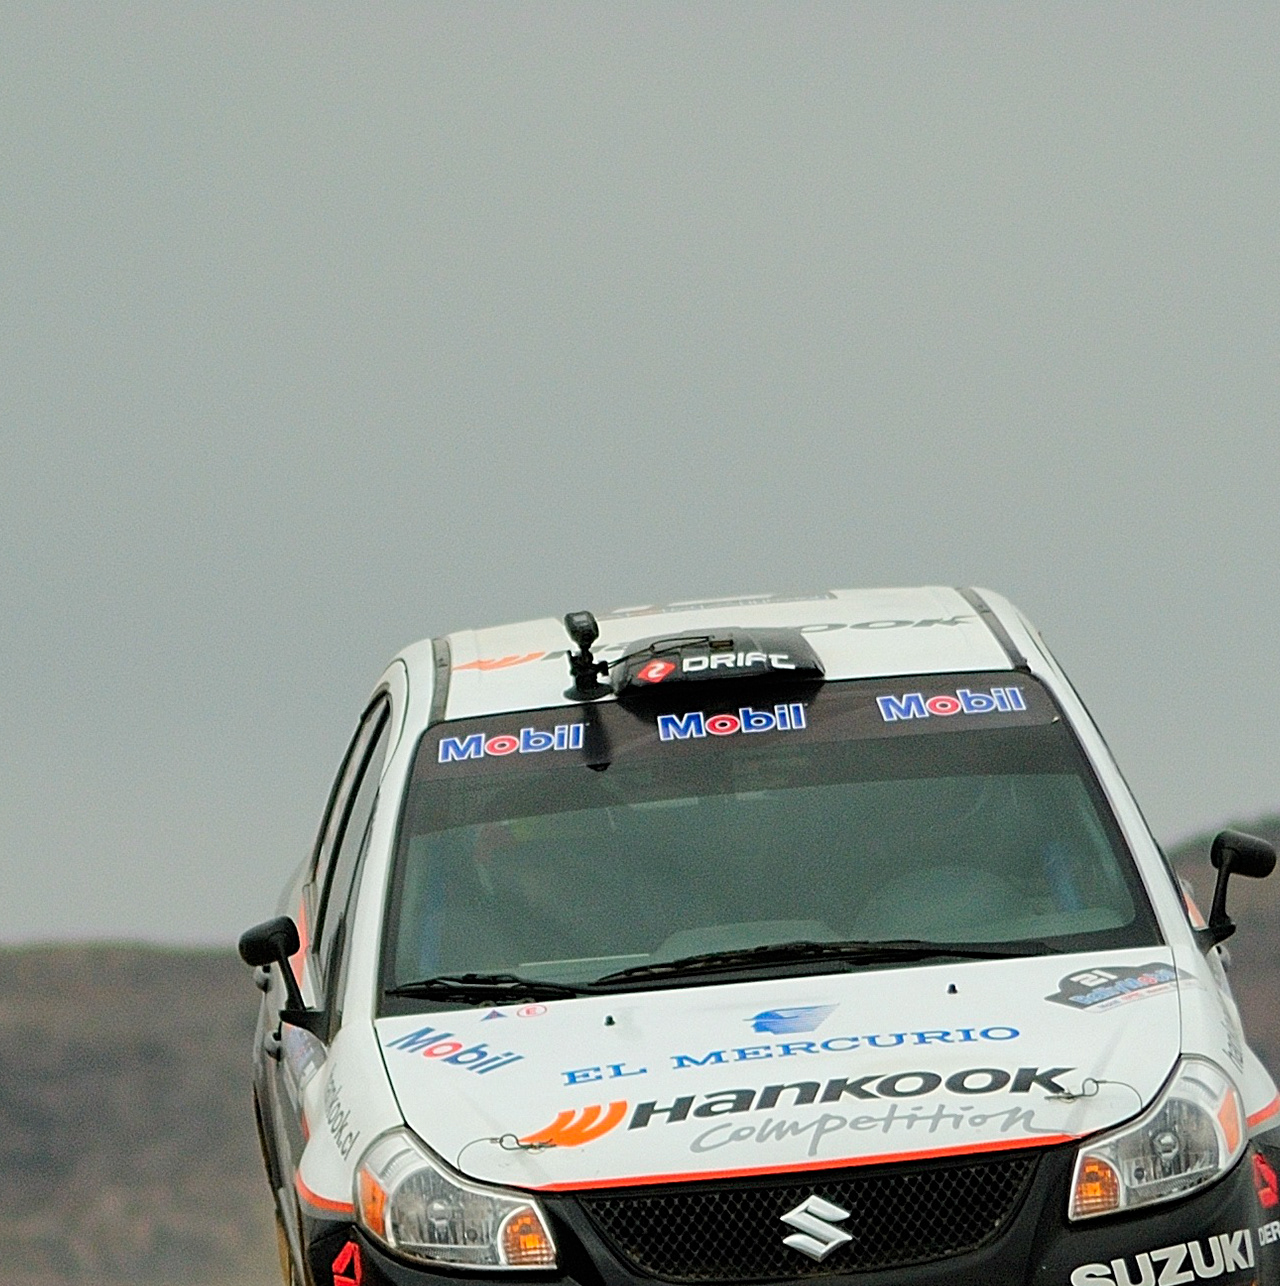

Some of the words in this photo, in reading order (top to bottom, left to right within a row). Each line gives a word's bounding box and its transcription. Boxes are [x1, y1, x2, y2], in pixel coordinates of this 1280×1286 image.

[681, 651, 797, 673] DRIFT
[657, 703, 807, 742] Mobil
[875, 687, 1027, 723] Mobil
[437, 722, 585, 764] Mobil
[1070, 969, 1118, 987] 21
[385, 1026, 525, 1075] Mobil
[560, 1062, 648, 1087] EL
[671, 1026, 1020, 1070] MERCURIO
